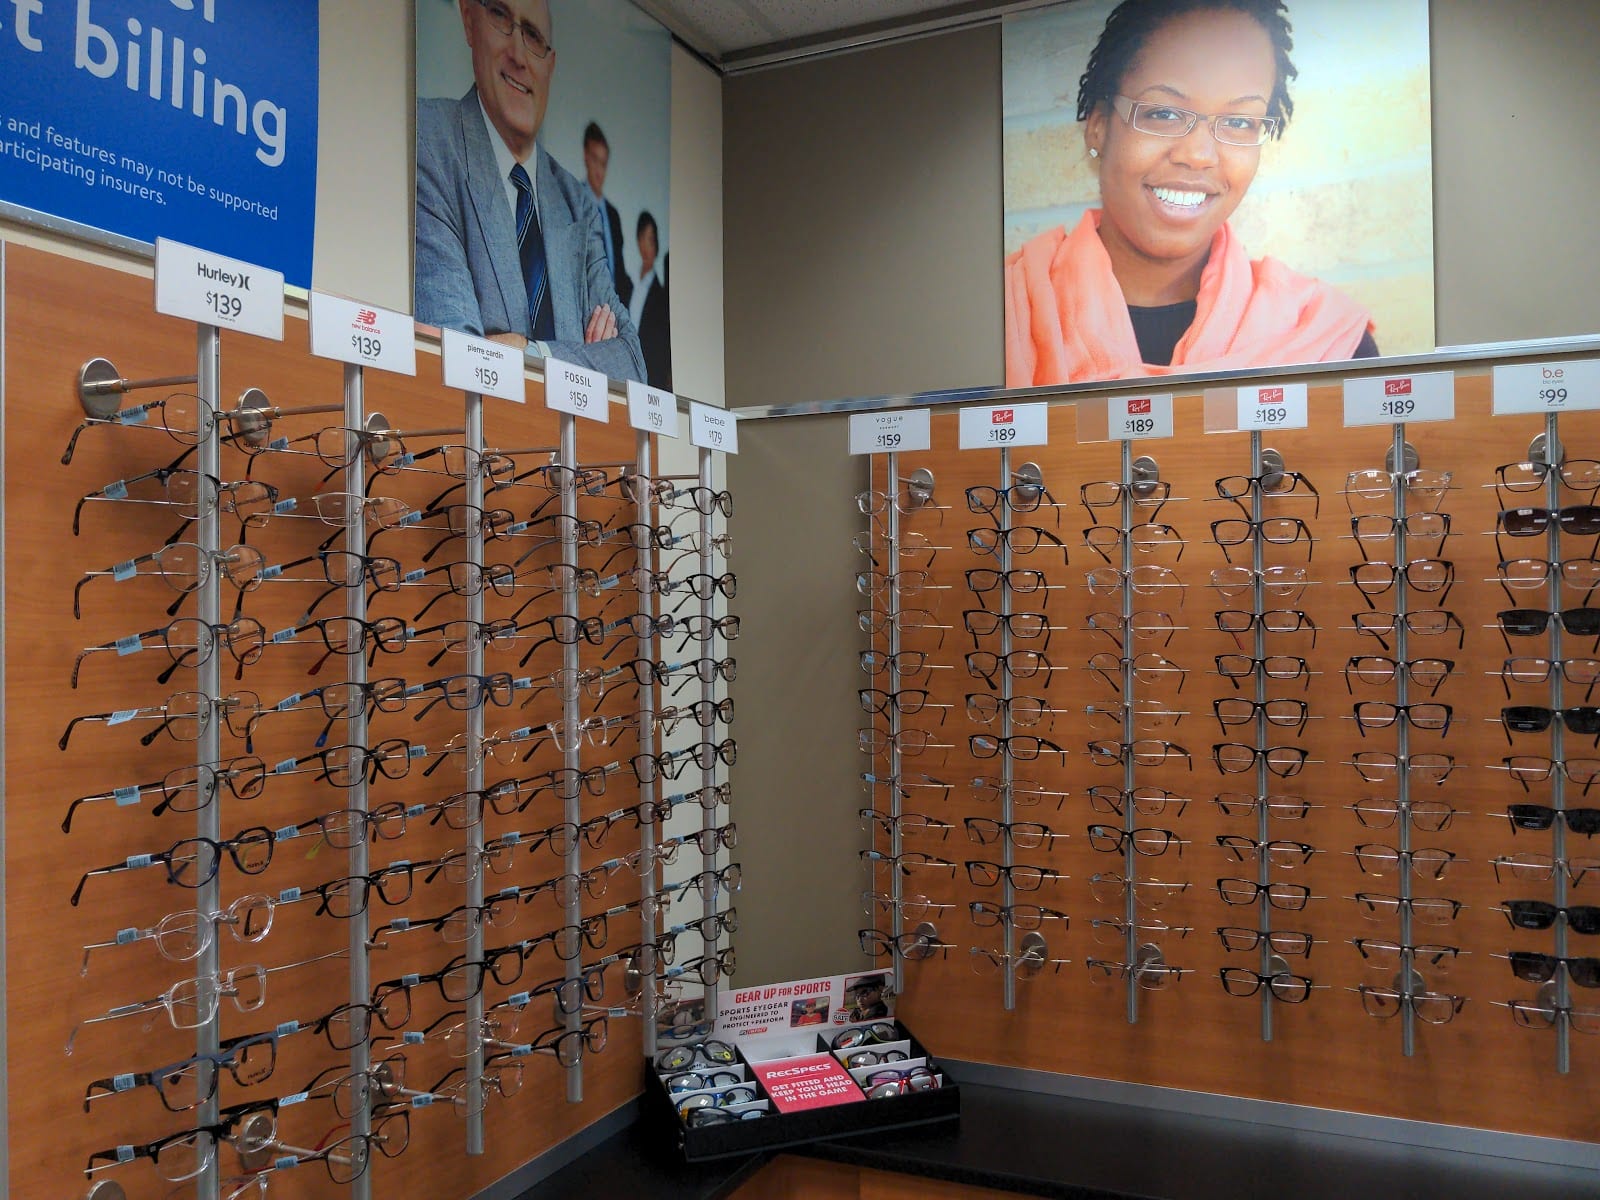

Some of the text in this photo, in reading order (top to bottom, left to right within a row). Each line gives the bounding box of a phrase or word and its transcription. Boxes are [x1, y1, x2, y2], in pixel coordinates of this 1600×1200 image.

[75, 0, 287, 168] billing
[7, 118, 41, 140] and
[45, 126, 117, 166] features
[120, 156, 154, 182] may
[157, 169, 184, 189] not
[187, 175, 206, 196] be
[209, 187, 279, 221] supported
[100, 167, 167, 206] insurers.
[197, 262, 238, 287] Hurley
[205, 290, 243, 317] $139
[351, 334, 382, 357] $139
[467, 344, 486, 355] pierre
[485, 349, 505, 360] cardin
[474, 366, 499, 387] $159
[564, 370, 592, 388] FOSSIL
[569, 390, 588, 408] $159
[1539, 388, 1568, 404] $99
[1256, 408, 1287, 422] $189
[1382, 399, 1415, 415] $189
[648, 410, 663, 427] $159
[703, 412, 726, 427] bebe
[874, 415, 904, 425] vogue
[1125, 418, 1154, 433] $189
[708, 429, 723, 444] $179
[877, 433, 901, 446] $159
[989, 428, 1016, 441] $189
[735, 981, 831, 1004] GEAR UP FOR SPORTS
[719, 1001, 789, 1017] SPORTS EYEGEAR
[730, 1012, 769, 1022] ENGINEERED
[722, 1021, 749, 1029] PROTECT
[755, 1016, 784, 1025] PERFORM
[770, 1079, 853, 1098] KEEP YOUR HEAD
[771, 1074, 845, 1092] GET FITTED AND
[799, 1091, 818, 1100] THE
[819, 1086, 849, 1096] GAME
